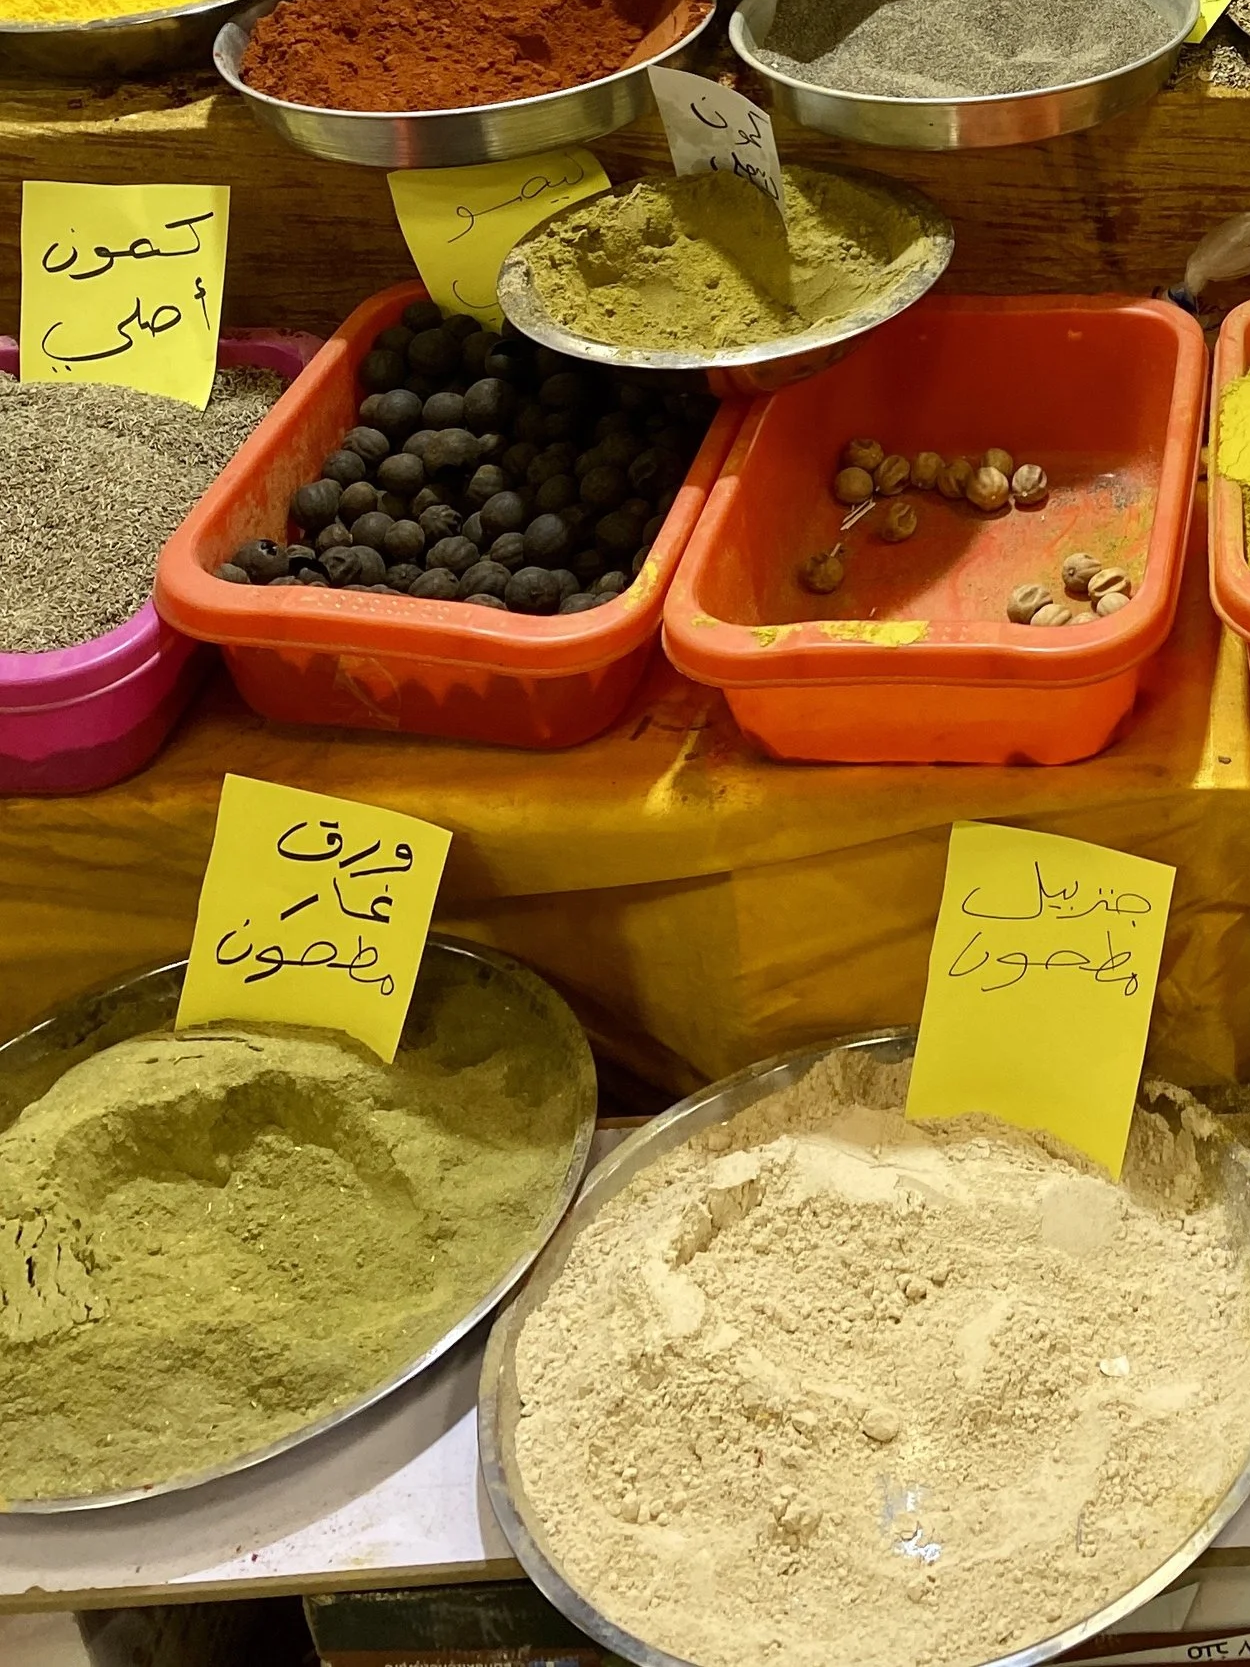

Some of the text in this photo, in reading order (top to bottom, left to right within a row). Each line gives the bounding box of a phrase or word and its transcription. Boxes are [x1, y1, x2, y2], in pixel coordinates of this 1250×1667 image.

[42, 211, 214, 280] كمون
[41, 276, 211, 374] أصلي
[276, 820, 414, 879] ورق
[279, 876, 394, 924] غار
[215, 918, 396, 996] مطحون
[1187, 1641, 1230, 1662] منذ
